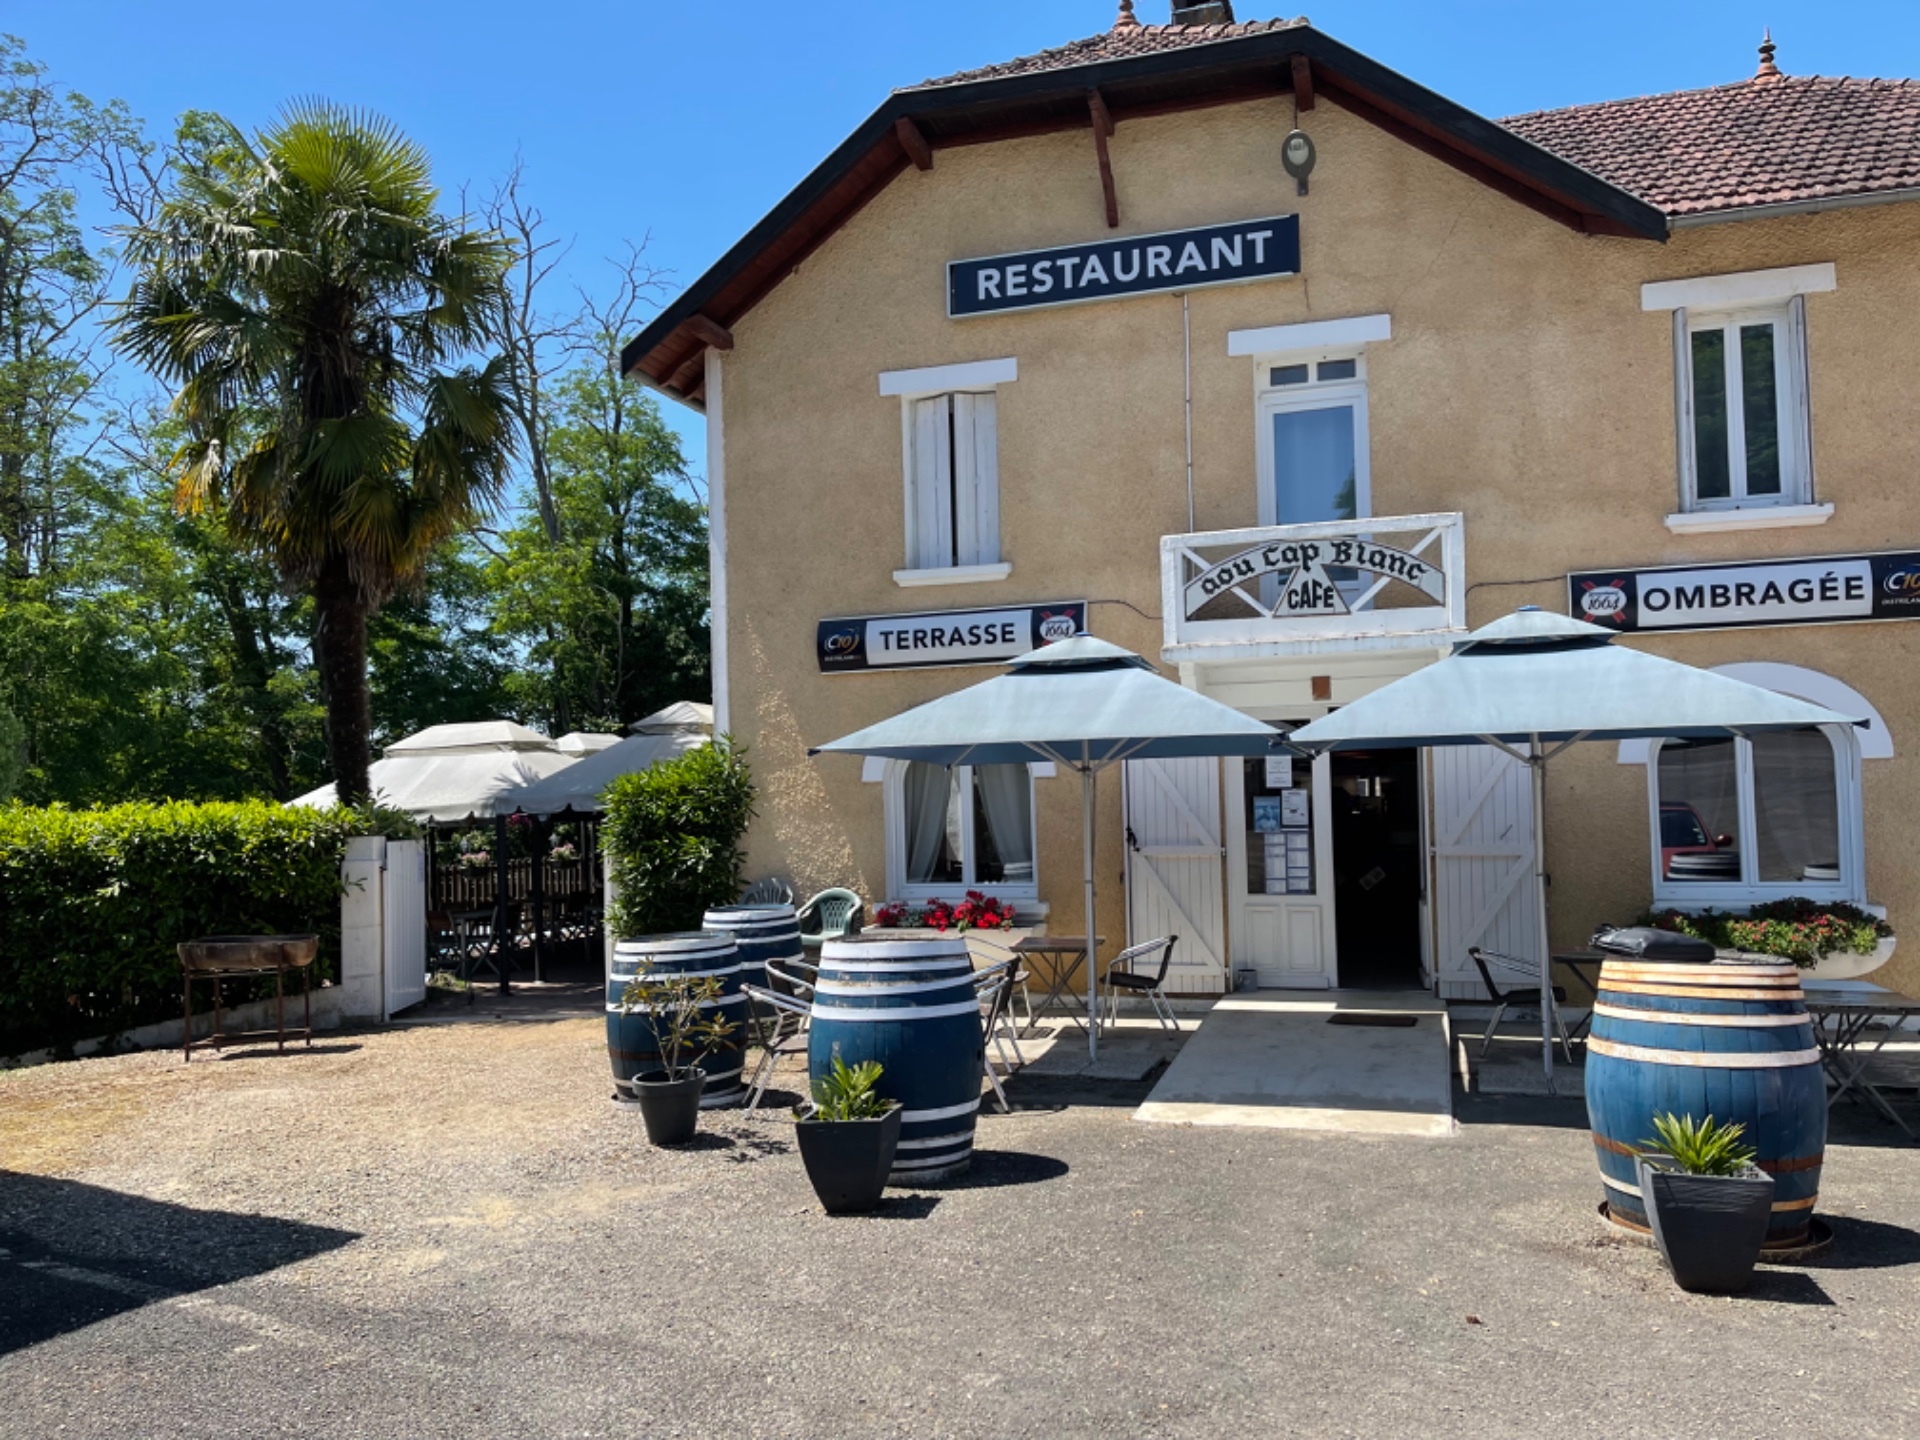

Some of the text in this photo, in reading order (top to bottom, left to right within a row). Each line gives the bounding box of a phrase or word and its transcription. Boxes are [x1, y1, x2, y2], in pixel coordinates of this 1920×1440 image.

[976, 229, 1274, 300] RESTAURANT
[1200, 539, 1428, 596] aou Cap Blanc
[1642, 571, 1866, 612] OMBRAGÉE
[879, 622, 1016, 651] TERRASSE
